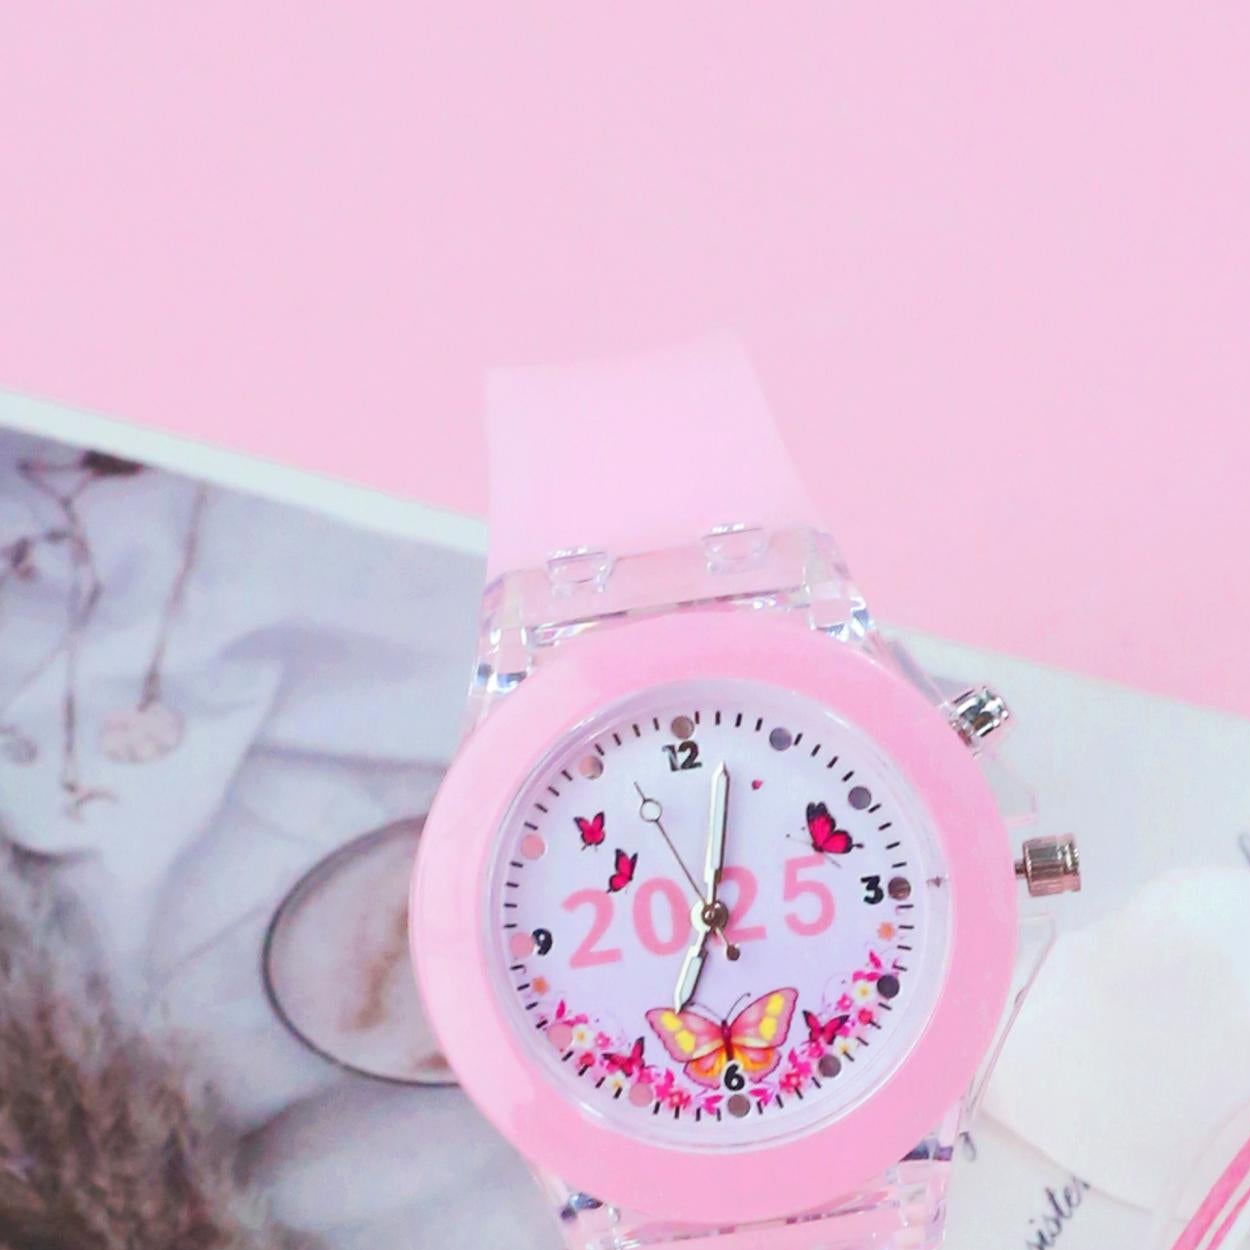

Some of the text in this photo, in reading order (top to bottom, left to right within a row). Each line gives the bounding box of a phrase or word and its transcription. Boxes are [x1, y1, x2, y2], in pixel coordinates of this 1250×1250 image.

[662, 741, 702, 772] 12
[861, 875, 884, 905] 3
[561, 856, 835, 970] 2025
[532, 928, 553, 956] 9
[724, 1064, 745, 1091] 6
